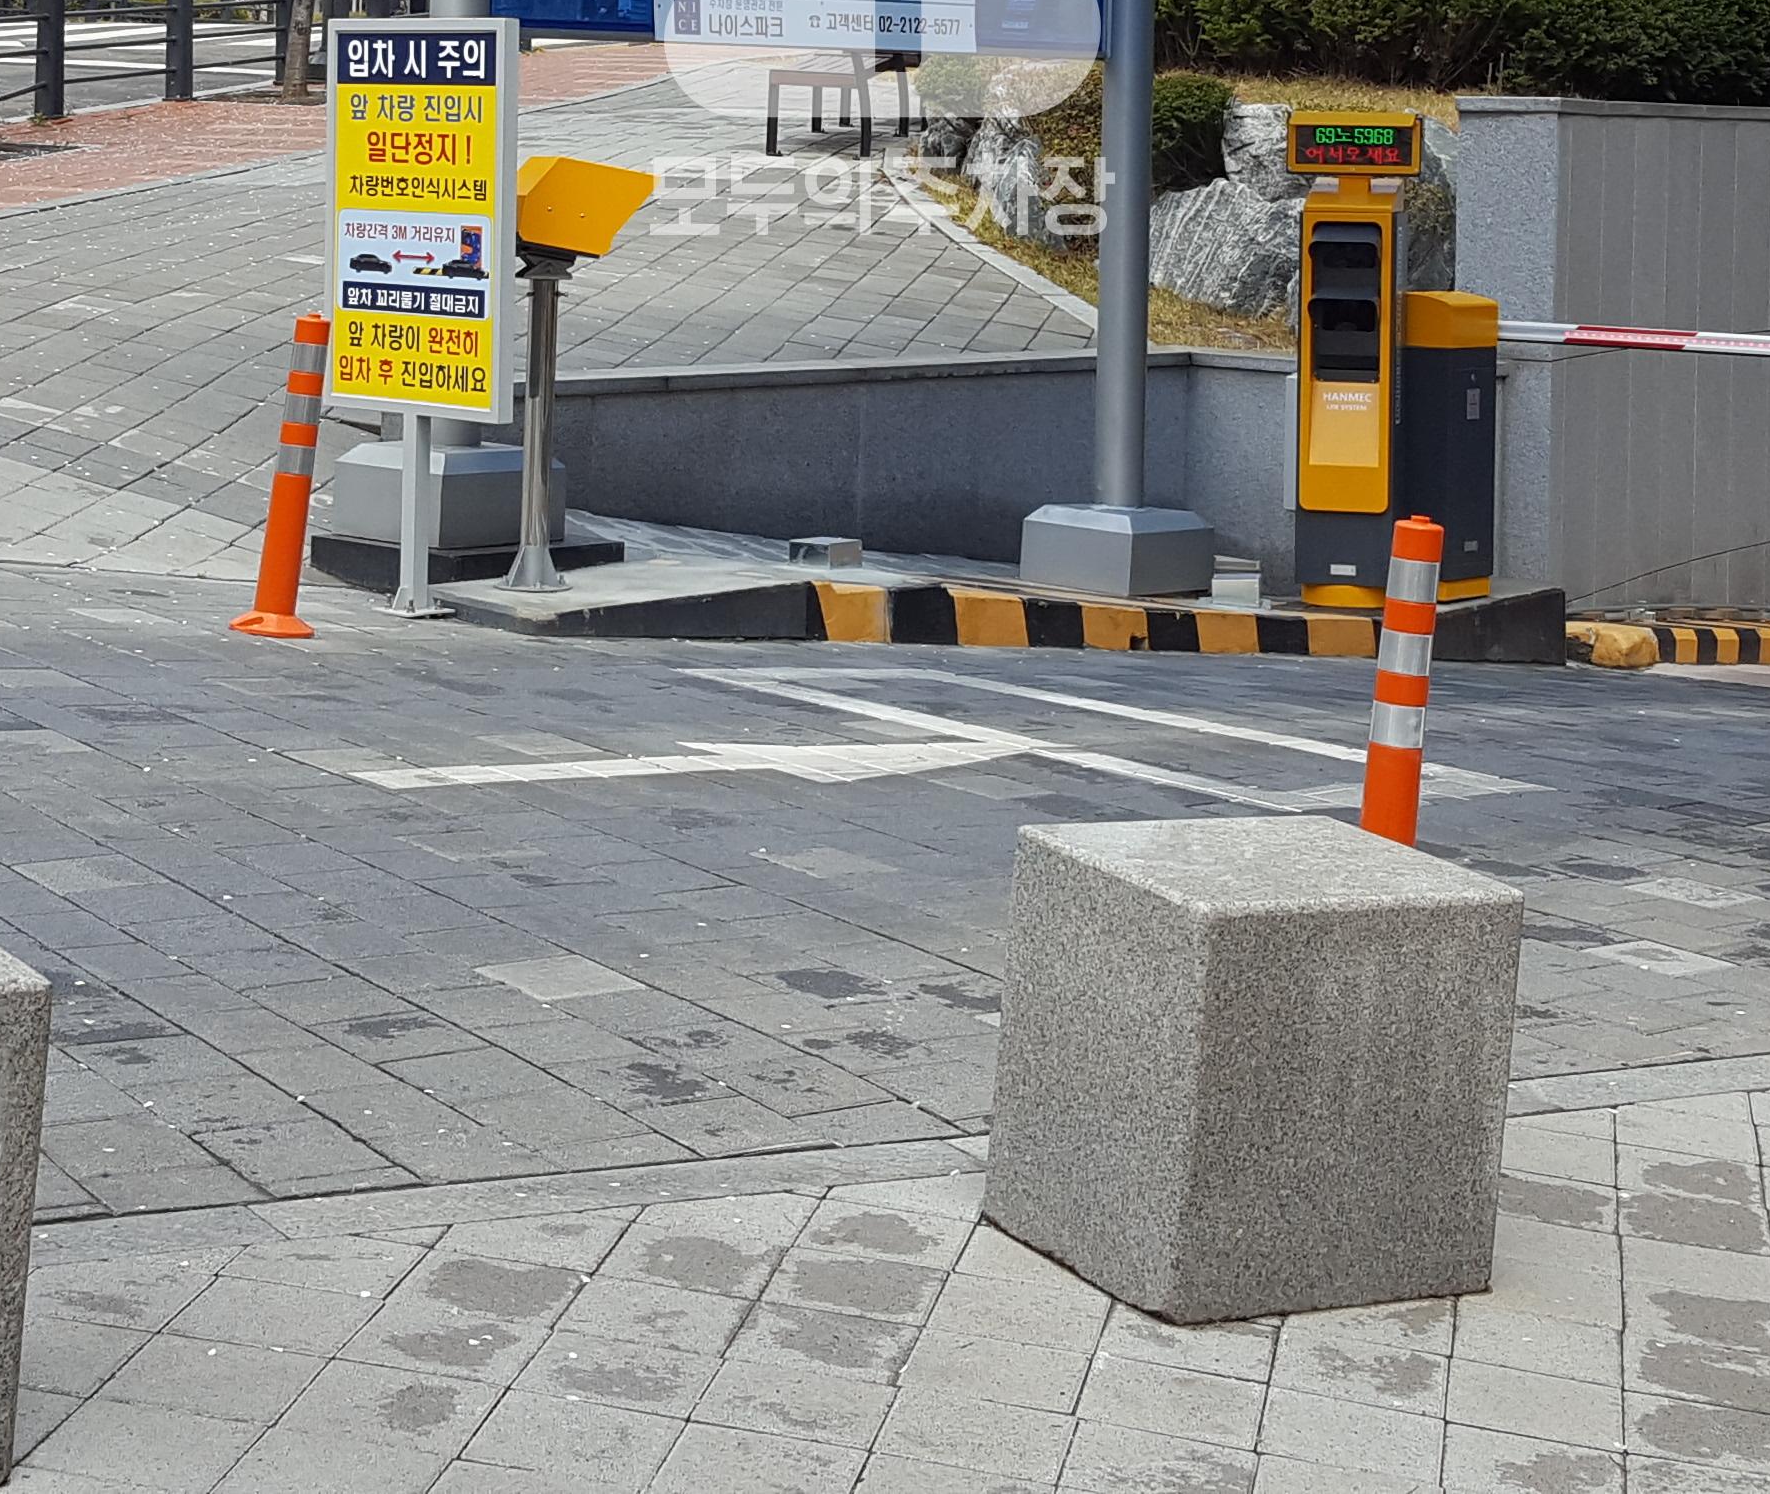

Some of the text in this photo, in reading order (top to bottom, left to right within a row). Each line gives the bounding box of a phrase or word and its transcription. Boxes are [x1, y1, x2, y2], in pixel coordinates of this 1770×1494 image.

[709, 13, 783, 38] 나이스파크
[826, 13, 960, 35] 고객센터 02-2122-5577
[348, 39, 486, 79] 입차 시 주의
[350, 94, 483, 124] 앞 차량 진입시
[349, 174, 488, 202] 차량번호인식시스템
[344, 222, 456, 244] 차량간격 3M 거리유지
[347, 288, 480, 315] 앞차 꼬리물기 절대금지
[348, 321, 480, 358] 앞 차량이 완전히
[339, 356, 487, 393] 입차 후 진입하세요
[1323, 392, 1373, 403] HANMEC
